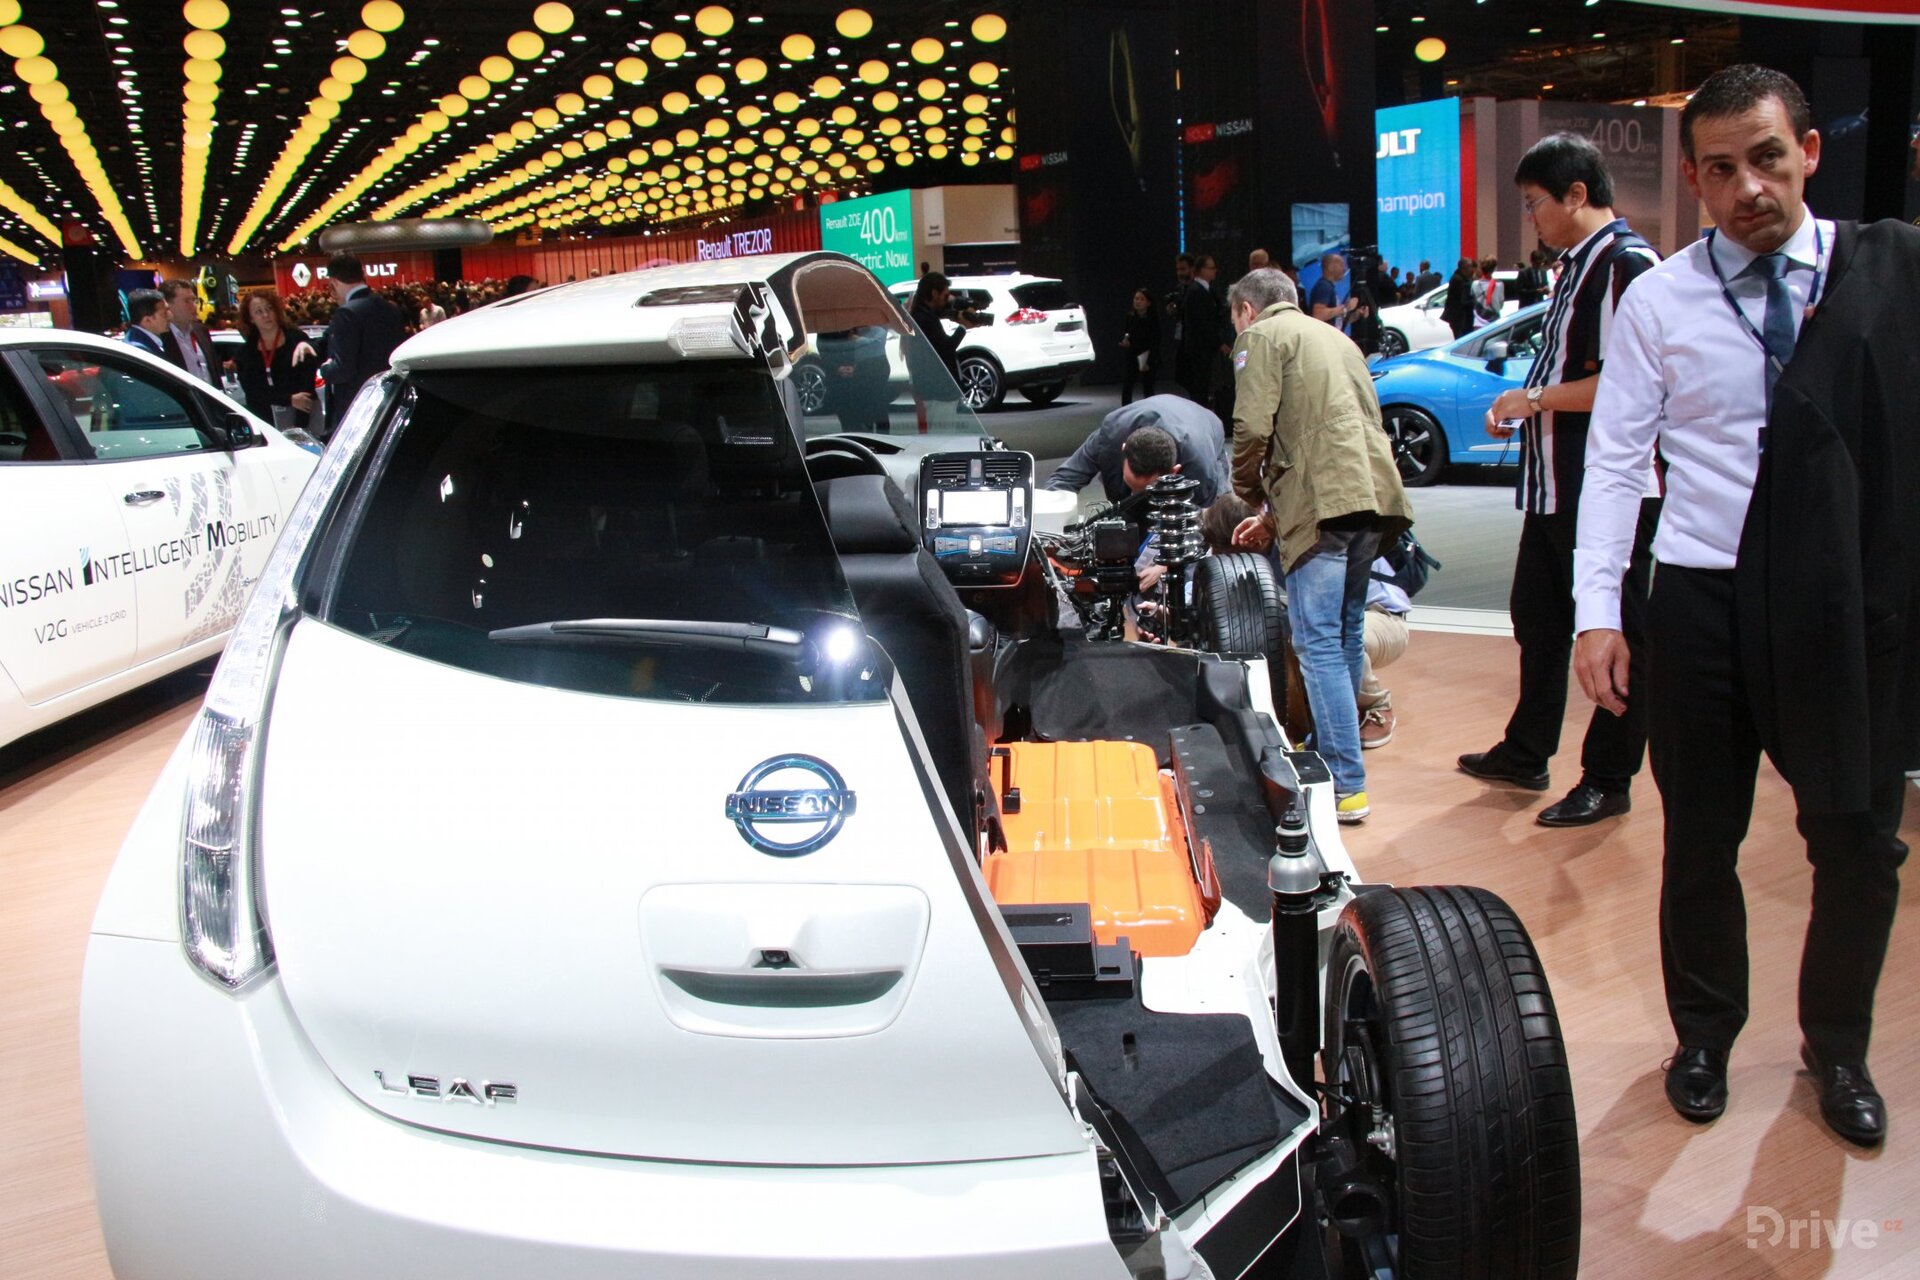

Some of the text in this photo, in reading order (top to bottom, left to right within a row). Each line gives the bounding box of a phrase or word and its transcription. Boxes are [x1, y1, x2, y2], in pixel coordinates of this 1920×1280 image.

[1216, 118, 1253, 138] NISSAN
[1376, 128, 1422, 159] ULT
[1589, 118, 1641, 154] 400
[825, 215, 848, 230] Renault
[848, 213, 862, 227] ZOE
[860, 206, 895, 246] 400
[697, 228, 772, 261] Renault TREZOR
[885, 249, 910, 268] Now.
[316, 263, 398, 280] RULT
[0, 513, 278, 608] NISSAN INTELLIGENT MOBILITY
[34, 619, 68, 644] V2G
[71, 617, 103, 634] VEHICLE
[736, 794, 844, 813] NISSAN
[374, 1070, 518, 1108] LEAF
